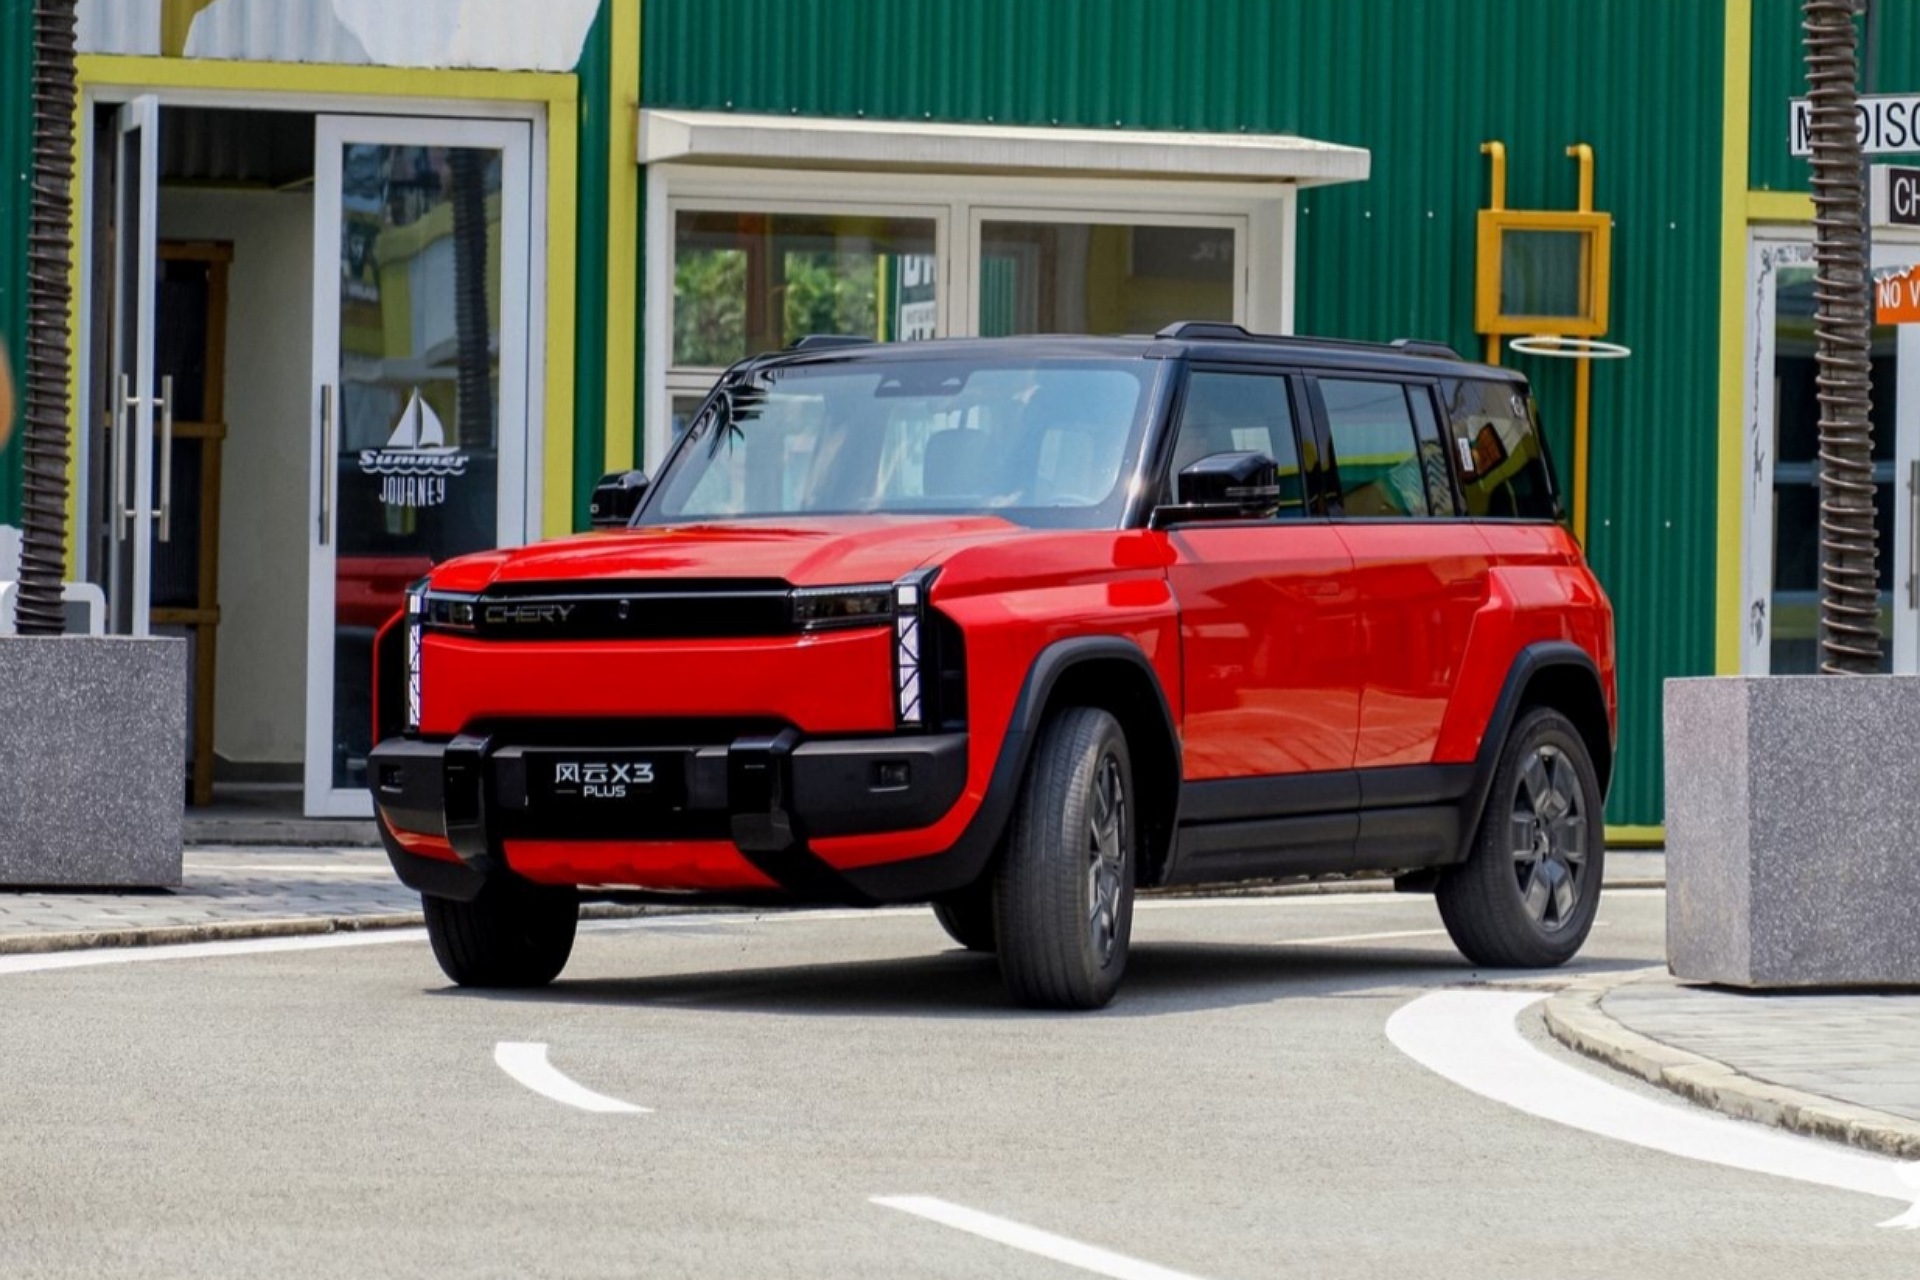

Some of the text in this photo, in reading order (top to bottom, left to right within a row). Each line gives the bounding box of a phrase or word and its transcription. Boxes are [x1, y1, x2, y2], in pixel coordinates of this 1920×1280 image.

[1879, 281, 1901, 309] NO
[359, 449, 470, 467] Summer
[485, 604, 576, 623] CHERY
[555, 763, 655, 784] 风云X3
[583, 785, 626, 798] PLUS
